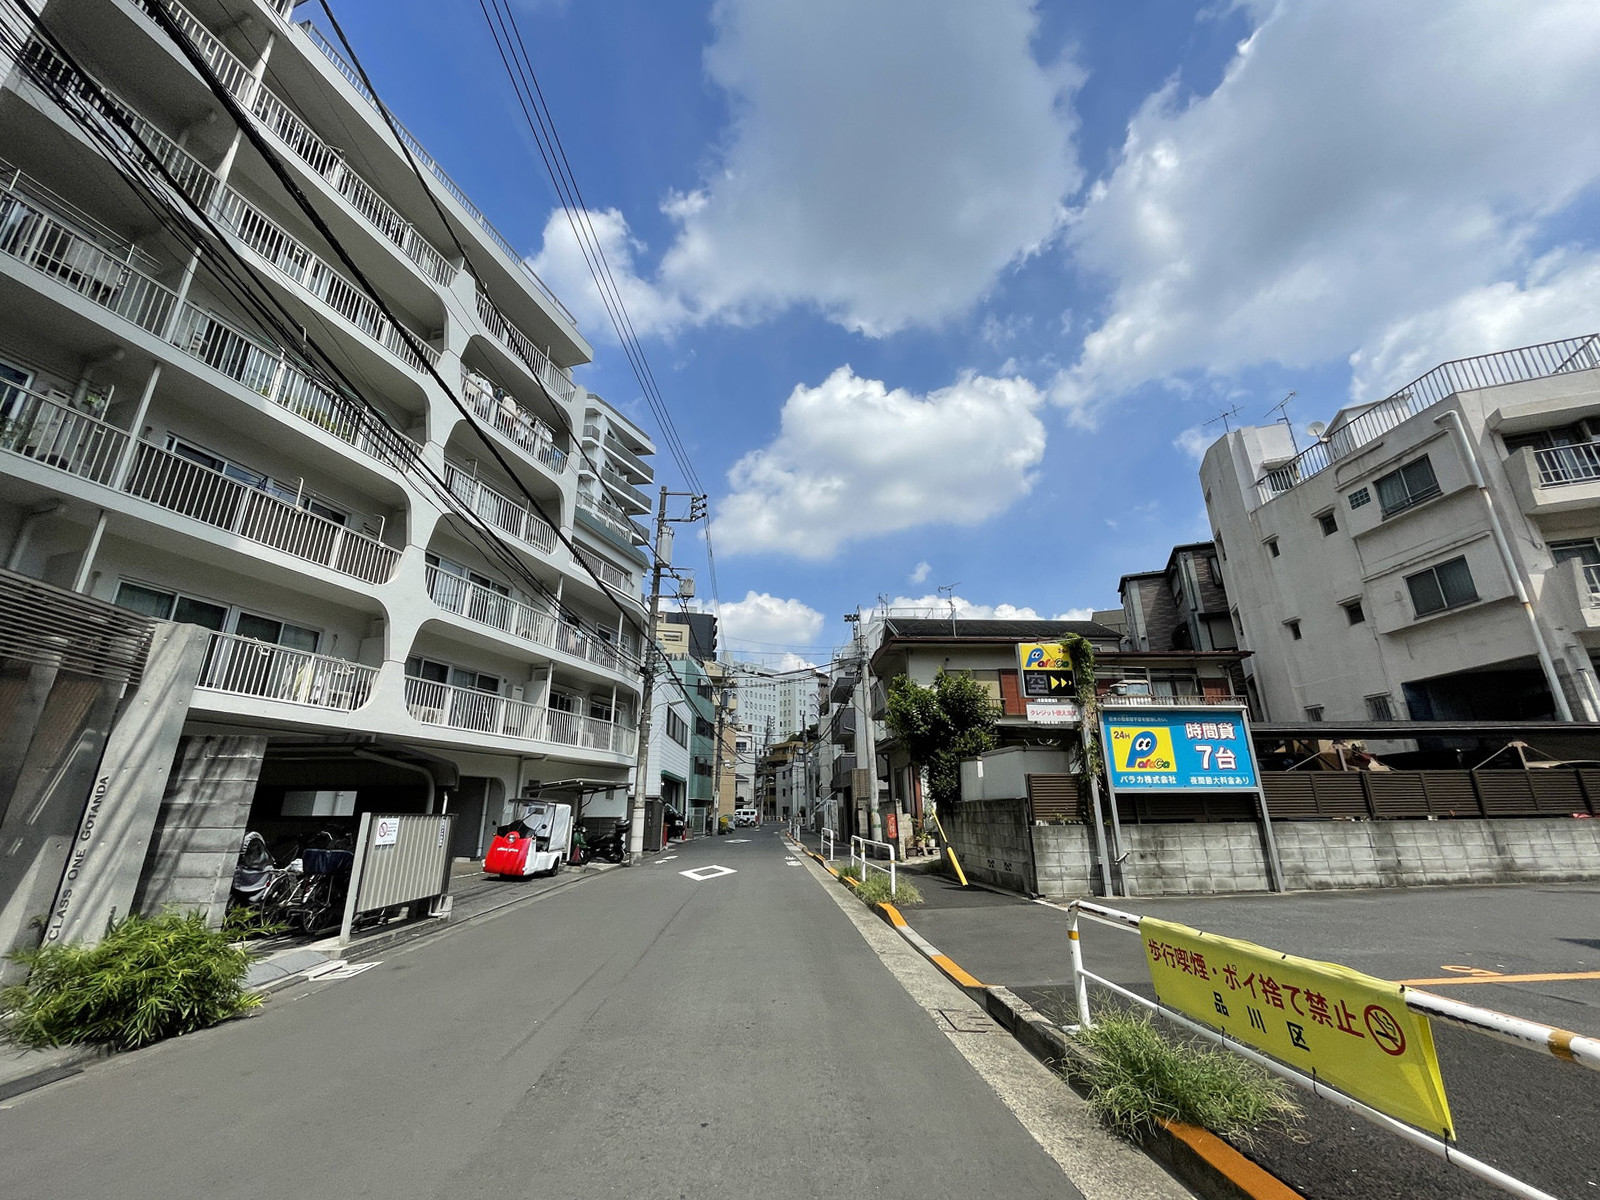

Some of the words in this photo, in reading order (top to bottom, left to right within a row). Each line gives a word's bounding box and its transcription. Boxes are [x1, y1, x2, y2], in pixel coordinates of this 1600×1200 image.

[1113, 731, 1130, 739] 24H
[1185, 722, 1236, 740] 時間貸
[1195, 745, 1236, 770] 7台
[1190, 776, 1249, 785] 夜間最大料金あり
[48, 888, 73, 941] CLASS
[67, 849, 86, 881] ONE
[80, 776, 109, 842] GOTANDA
[1148, 938, 1365, 1038] 歩行喫煙・ポイ捨て禁止
[1213, 991, 1311, 1052] 品川区
